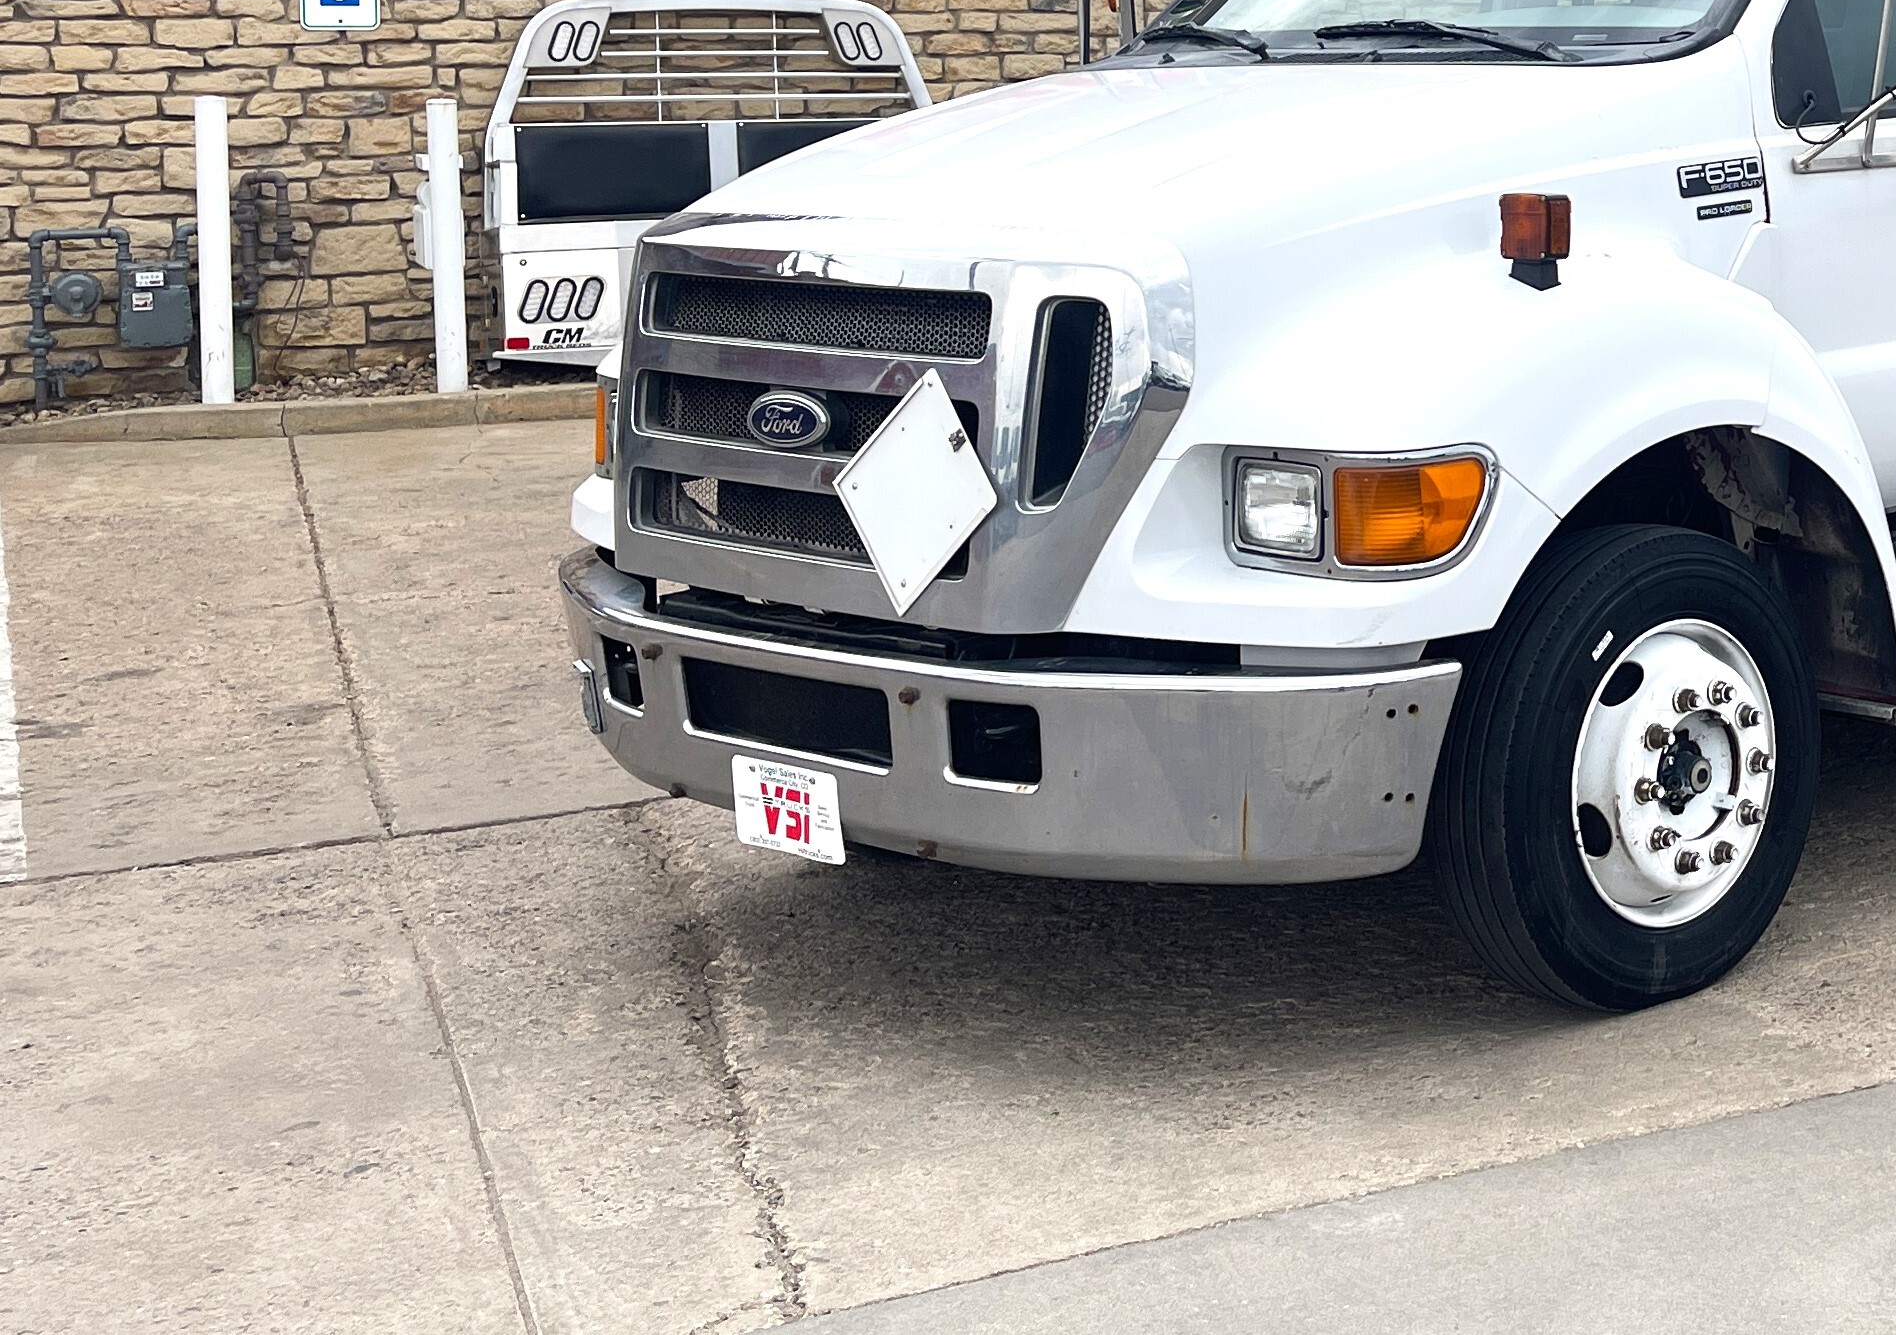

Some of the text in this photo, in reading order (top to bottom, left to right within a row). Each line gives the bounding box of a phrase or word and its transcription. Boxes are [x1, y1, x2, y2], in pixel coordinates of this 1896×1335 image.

[1711, 179, 1763, 192] SUPER DUTY
[1700, 207, 1718, 216] PRO
[542, 327, 584, 344] CM
[761, 405, 803, 434] Ford
[758, 764, 777, 776] Vogel
[779, 768, 796, 779] Sales
[760, 782, 810, 844] VSI
[775, 799, 811, 814] TRUCKS
